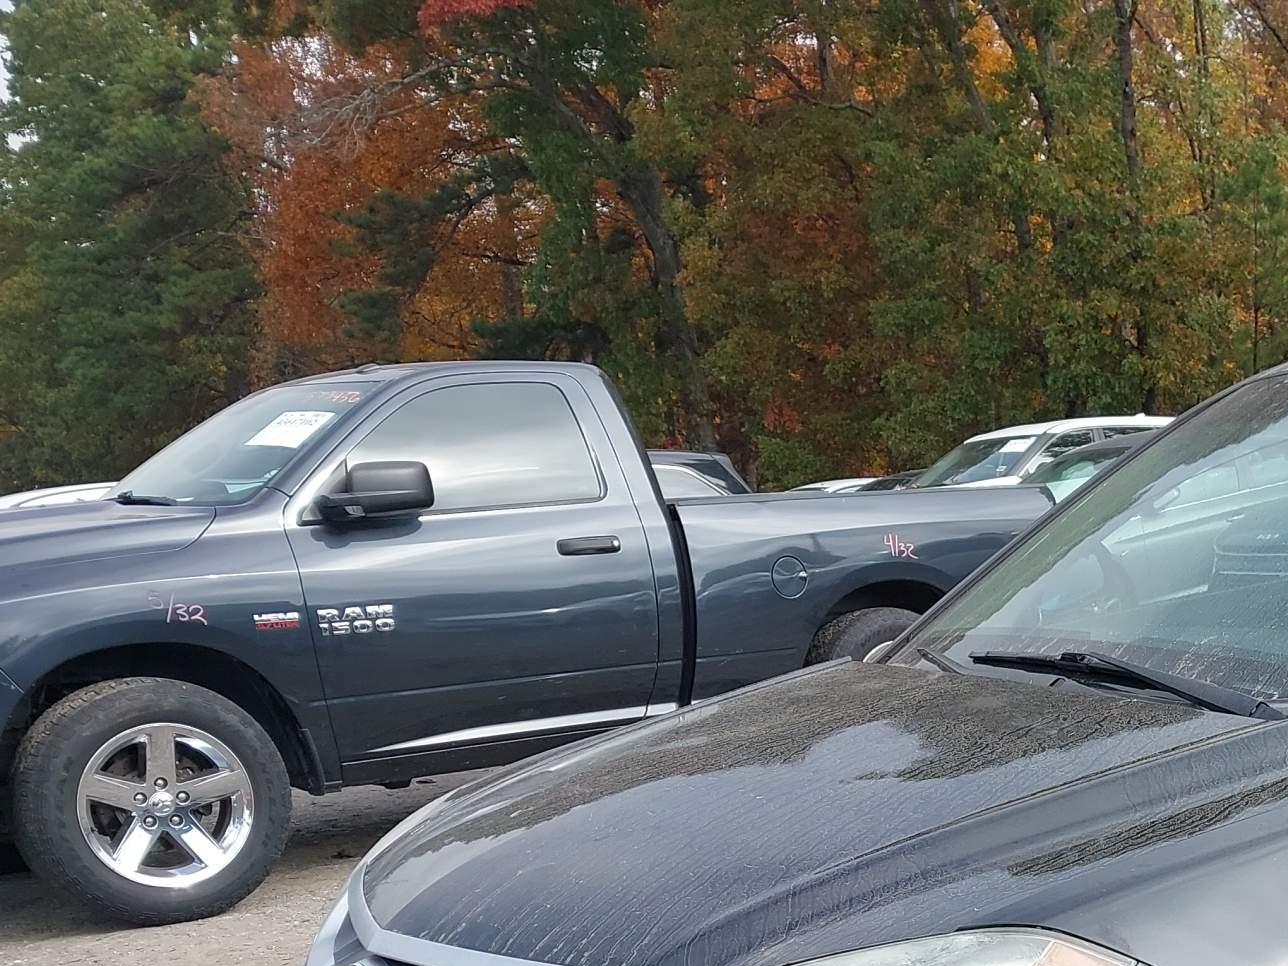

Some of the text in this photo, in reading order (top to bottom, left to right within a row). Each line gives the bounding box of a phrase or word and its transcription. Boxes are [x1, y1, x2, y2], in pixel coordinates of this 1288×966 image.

[252, 611, 299, 623] HEMI
[317, 604, 394, 622] RAM
[318, 618, 396, 636] 1500
